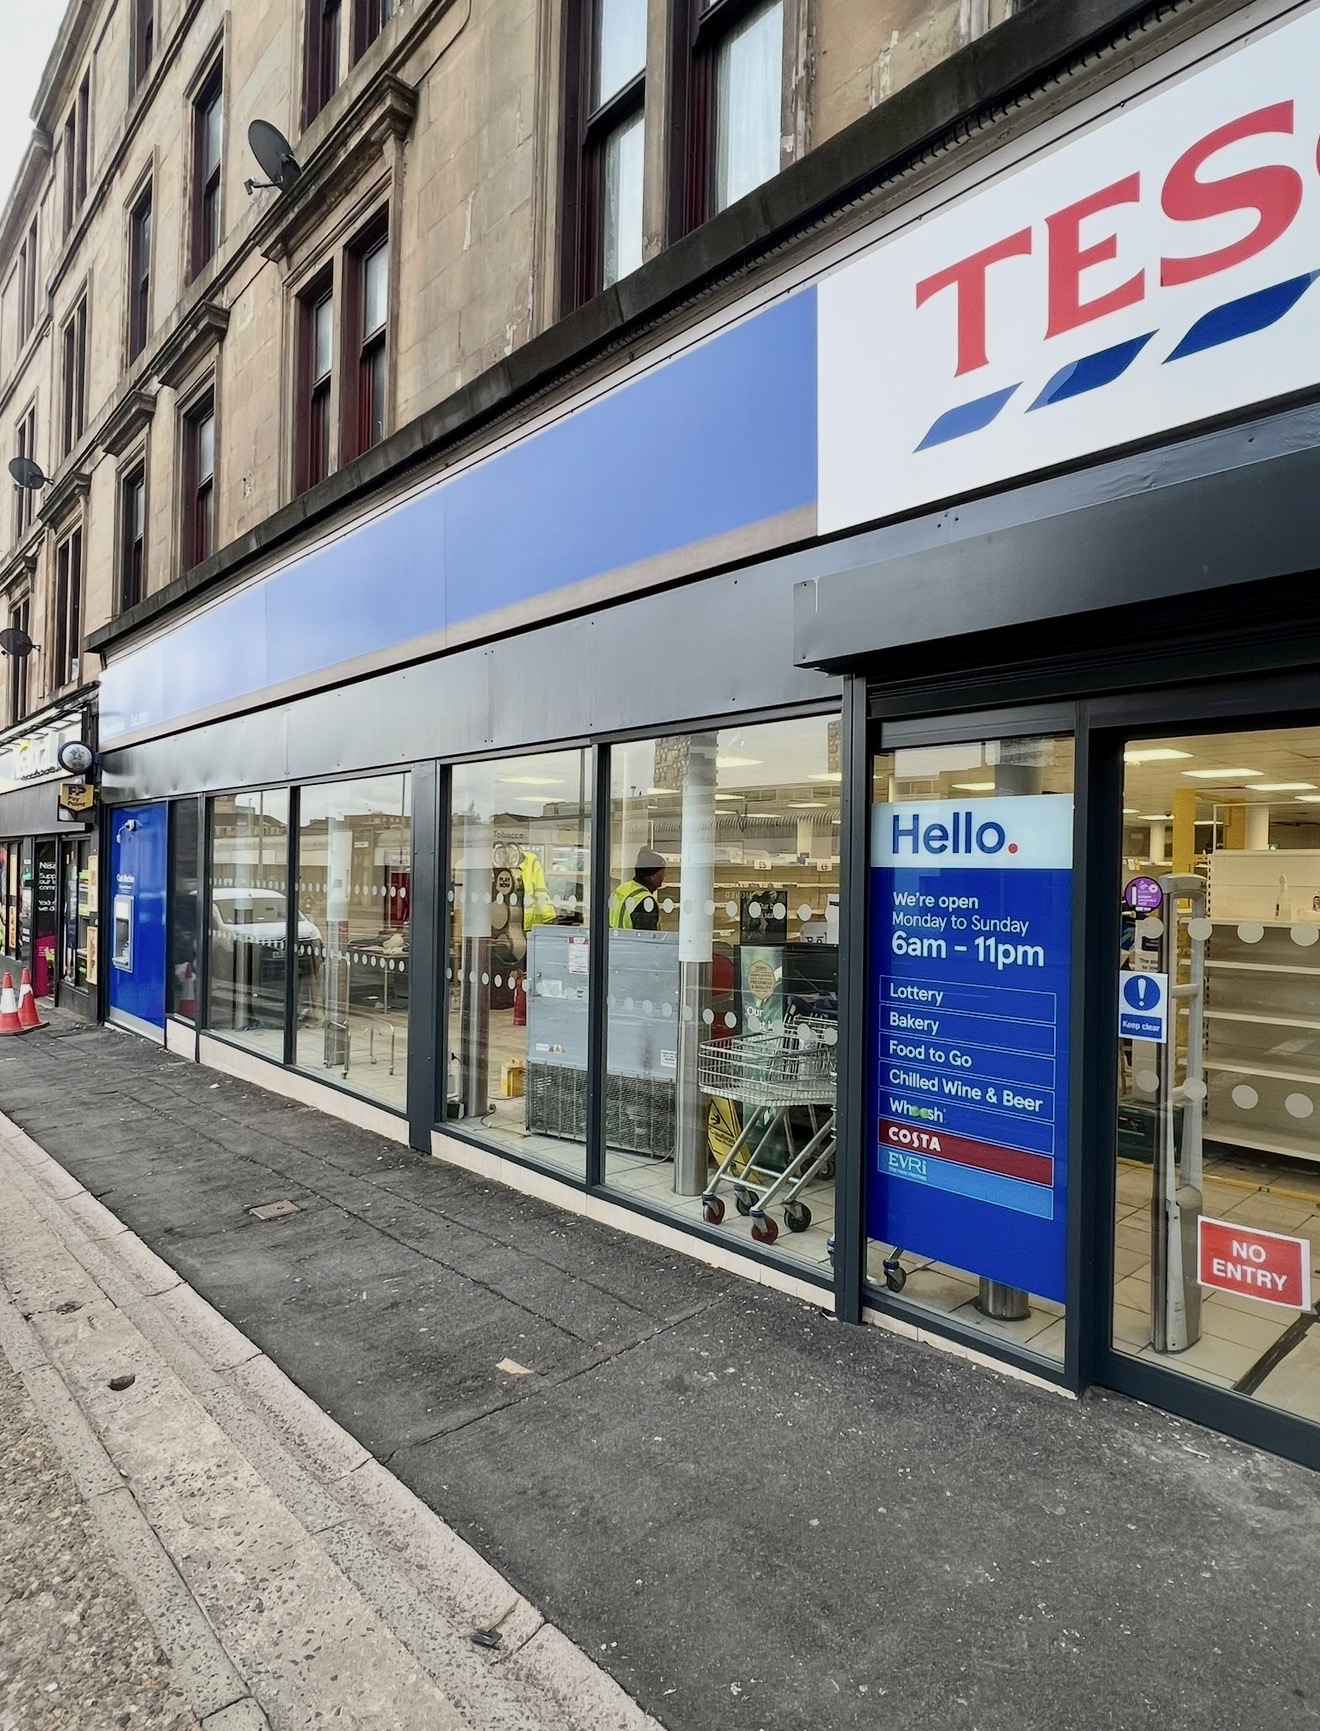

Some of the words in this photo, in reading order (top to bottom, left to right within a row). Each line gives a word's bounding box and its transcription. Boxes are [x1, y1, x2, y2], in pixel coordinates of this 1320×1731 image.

[916, 99, 1320, 377] TES
[68, 800, 86, 808] Point
[493, 831, 525, 839] Tobacco
[892, 811, 1018, 854] Hello.
[758, 861, 767, 869] £5
[892, 891, 935, 908] We're
[938, 895, 979, 912] open
[892, 911, 947, 932] Monday
[951, 915, 967, 930] to
[971, 915, 1029, 937] Sunday
[891, 931, 947, 959] 6am
[974, 935, 1045, 970] 11pm
[890, 983, 944, 1006] Lottery
[747, 1006, 764, 1017] Our
[889, 1012, 940, 1035] Bakery
[1122, 1018, 1140, 1031] Keep
[1141, 1020, 1161, 1033] clear
[889, 1040, 925, 1060] Food
[929, 1047, 945, 1063] to
[949, 1050, 973, 1068] Go
[889, 1069, 939, 1092] Chilled
[942, 1077, 982, 1100] Wine
[986, 1087, 998, 1104] &
[1003, 1089, 1044, 1112] Beer
[888, 1126, 942, 1152] COSTA
[1232, 1239, 1267, 1263] NO
[1212, 1258, 1288, 1292] ENTRY
